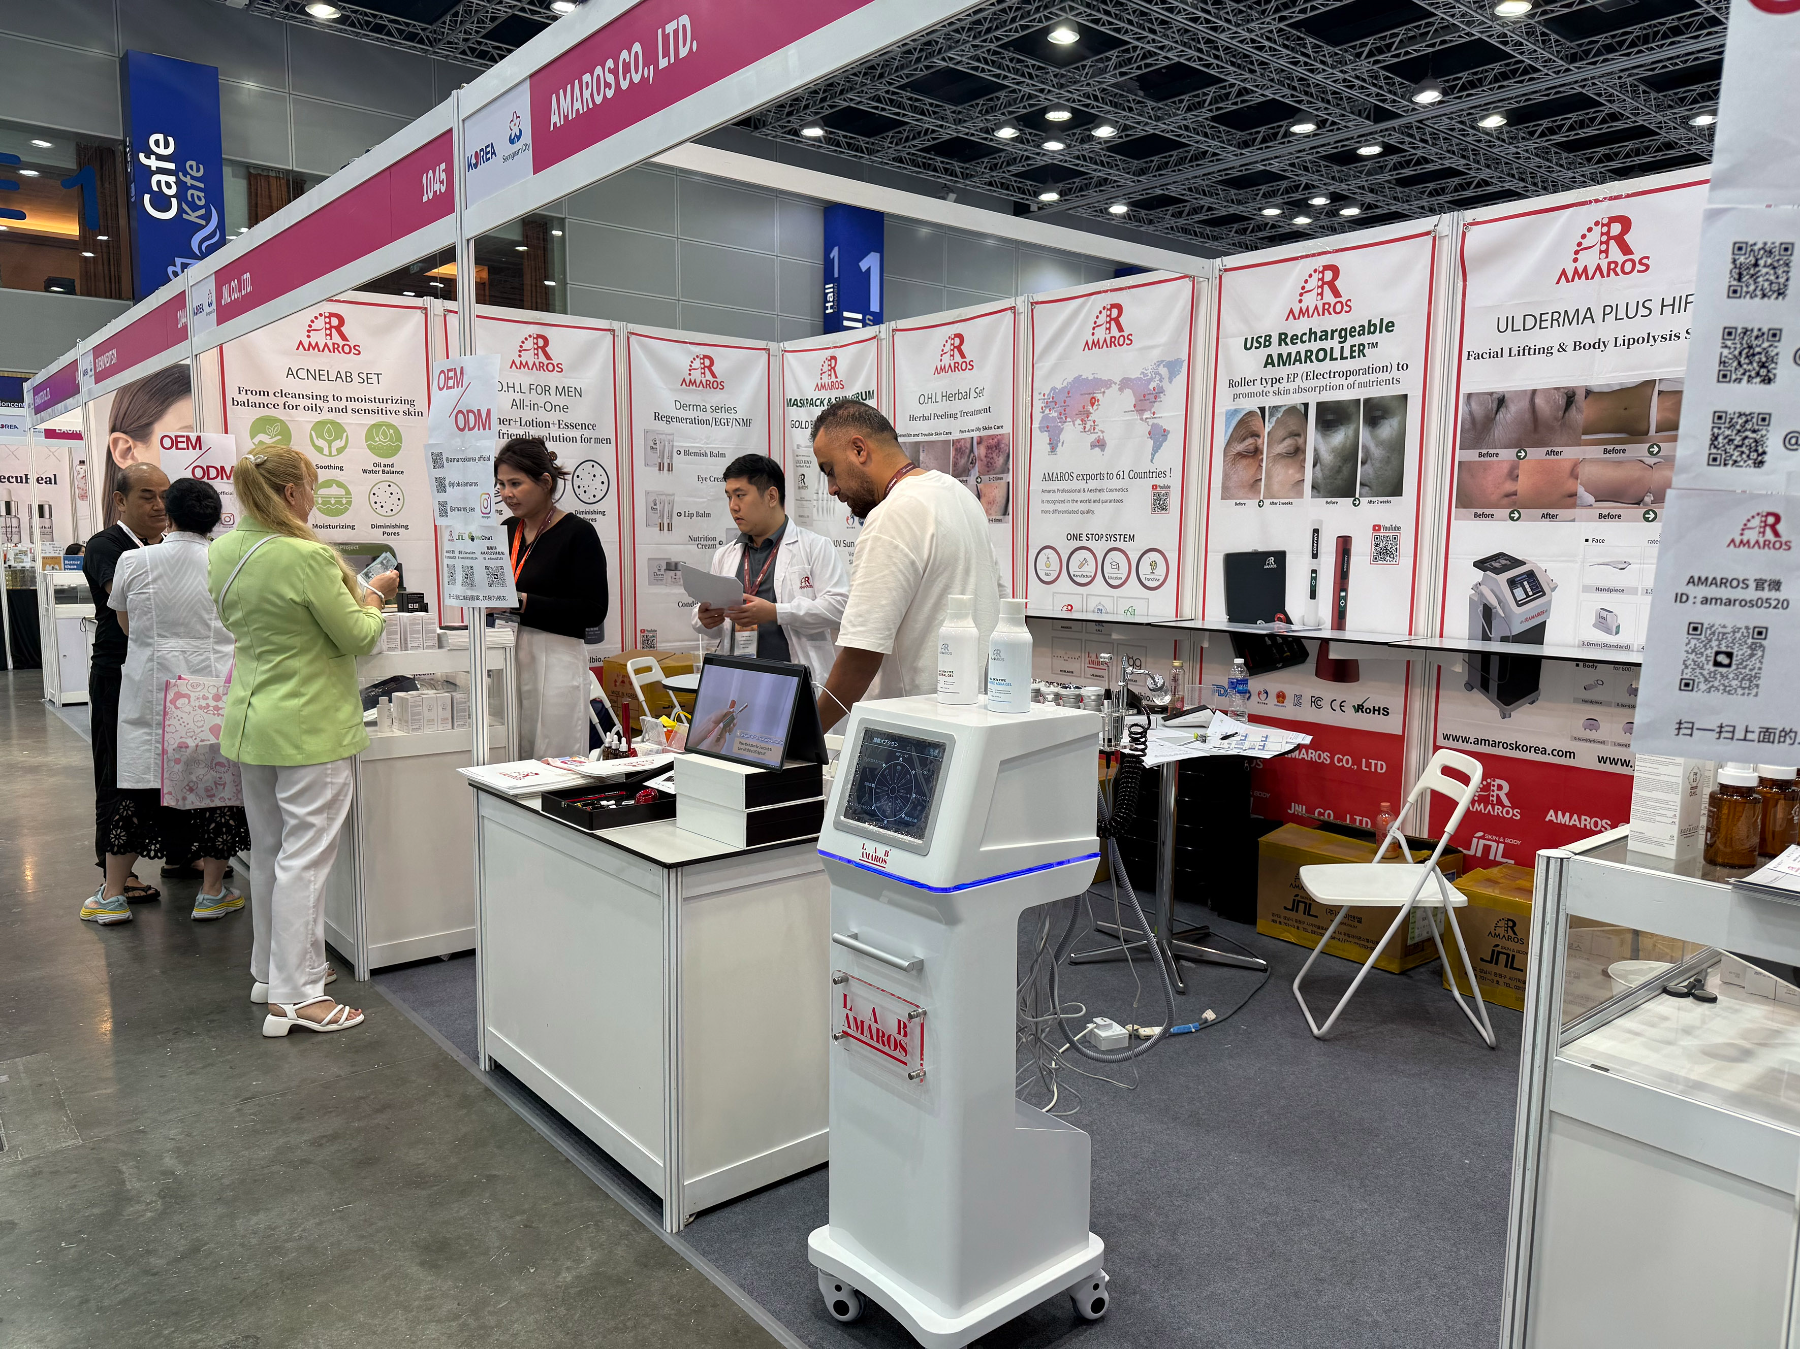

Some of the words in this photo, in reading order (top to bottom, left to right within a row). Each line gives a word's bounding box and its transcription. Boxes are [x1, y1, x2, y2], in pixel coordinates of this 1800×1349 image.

[550, 58, 615, 132] AMAROS
[618, 41, 654, 85] CO.,
[658, 14, 697, 70] LTD.
[467, 142, 497, 172] KOREA
[138, 132, 178, 220] Cafe
[422, 162, 446, 202] 1045
[181, 160, 206, 224] Kafe
[1555, 256, 1650, 285] AMAROS
[858, 252, 880, 312] 1
[825, 283, 834, 314] Hall
[1285, 298, 1352, 322] AMAROS
[1496, 306, 1596, 334] ULDERMA
[1602, 298, 1652, 323] PLUS
[1082, 333, 1133, 352] AMAROS
[1244, 334, 1272, 351] USB
[1278, 318, 1396, 347] Rechargeable
[296, 340, 362, 356] AMAROS
[1466, 346, 1504, 361] Facial
[1508, 344, 1554, 359] Lifting
[1557, 341, 1568, 353] &
[1572, 338, 1610, 353] Body
[1613, 329, 1681, 349] Lipolysis
[286, 366, 352, 384] ACNELAB
[358, 372, 382, 384] SET
[510, 359, 563, 373] AMAROS
[933, 360, 974, 375] AMAROS
[437, 366, 464, 392] OEM
[680, 378, 725, 390] AMAROS
[1228, 376, 1258, 389] Roller
[1260, 375, 1284, 388] type
[1286, 373, 1298, 384] EP
[1301, 362, 1393, 384] (Electroporation)
[1396, 362, 1409, 372] to
[529, 383, 551, 396] FOR
[555, 385, 582, 398] MEN
[814, 380, 844, 392] AMAROS
[1232, 389, 1270, 402] promote
[1272, 386, 1291, 397] skin
[1292, 383, 1344, 395] absorption
[1346, 380, 1356, 390] of
[1357, 376, 1401, 389] nutrients
[237, 386, 270, 397] From
[273, 388, 329, 403] cleansing
[332, 392, 342, 402] to
[345, 394, 416, 407] moisturizing
[826, 398, 833, 406] &
[918, 393, 939, 405] O.H.L
[941, 388, 971, 402] Herbal
[974, 386, 985, 398] Set
[231, 397, 280, 410] balance
[283, 400, 300, 410] for
[303, 401, 324, 414] oily
[327, 405, 348, 414] and
[351, 406, 400, 416] sensitive
[402, 408, 423, 417] skin
[510, 398, 569, 414] All-in-One
[674, 400, 707, 413] Derma
[710, 404, 738, 414] series
[909, 413, 931, 422] Herbal
[933, 411, 958, 420] Peeling
[959, 406, 992, 417] Treatment
[454, 408, 491, 432] ODM
[654, 411, 752, 428] Regeneration/EGF/NMF
[160, 435, 202, 450] OEM
[580, 434, 592, 444] for
[594, 437, 611, 445] men
[683, 449, 709, 458] Blemish
[710, 450, 726, 458] Balm
[1603, 446, 1626, 455] Before
[315, 463, 344, 471] Soothing
[1042, 471, 1074, 483] AMAROS
[1076, 470, 1105, 484] exports
[1106, 470, 1114, 480] to
[1116, 470, 1125, 480] 61
[1128, 468, 1167, 480] Countries
[697, 475, 708, 483] Eye
[684, 511, 694, 520] Lip
[1598, 511, 1622, 520] Before
[1066, 533, 1083, 541] ONE
[1085, 533, 1104, 542] STOP
[1105, 534, 1135, 542] SYSTEM
[1726, 537, 1792, 551] AMAROS
[1595, 586, 1624, 594] Handpiece
[1686, 575, 1750, 590] AMAROS
[1754, 578, 1782, 593] 官微
[1674, 592, 1690, 604] ID
[1700, 596, 1790, 610] amaros0520
[1442, 732, 1576, 760] www.amaroskorea.com
[1334, 755, 1357, 770] CO.,
[1362, 758, 1386, 773] LTD
[1545, 809, 1612, 832] AMAROS
[860, 850, 888, 866] AMAROS
[1487, 931, 1524, 945] AMAROS
[842, 1013, 908, 1058] AMAROS
